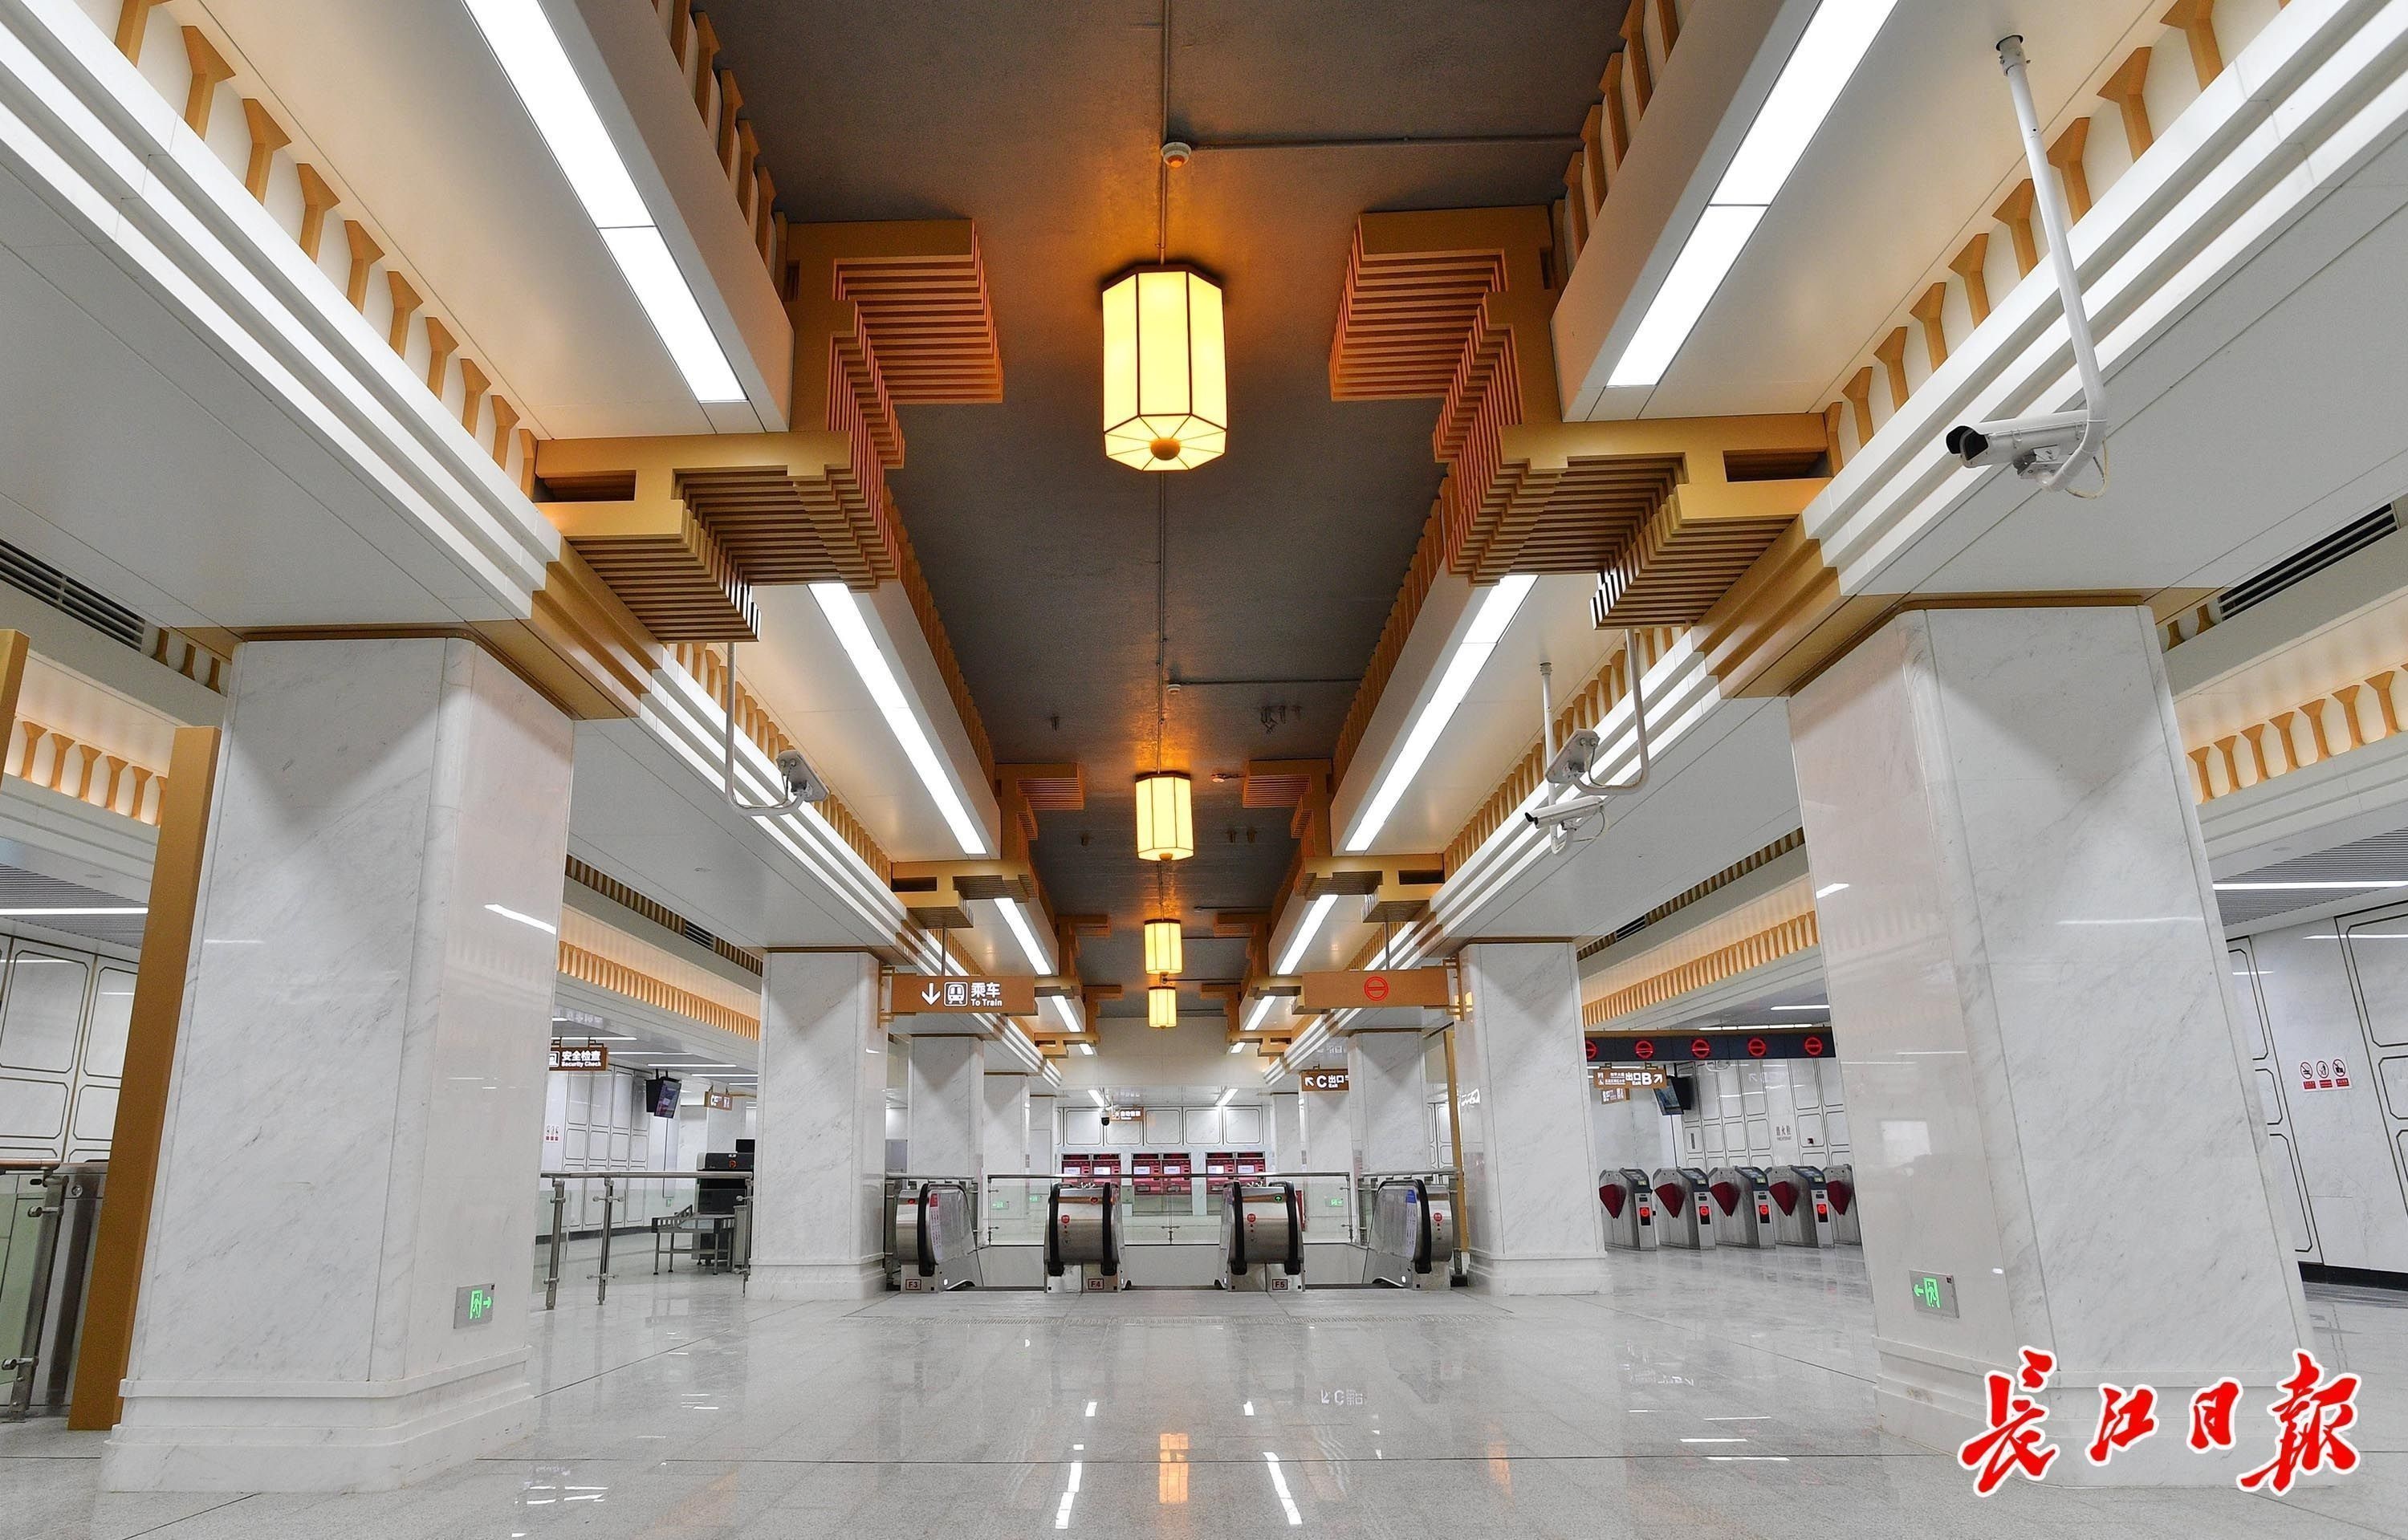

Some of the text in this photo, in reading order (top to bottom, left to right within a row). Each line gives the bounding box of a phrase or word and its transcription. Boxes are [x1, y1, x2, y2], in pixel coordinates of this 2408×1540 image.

[971, 982, 1000, 998] 乘车
[970, 998, 1003, 1006] To Train
[562, 1050, 600, 1061] 安全检查
[1328, 1075, 1344, 1083] 出口
[1625, 1071, 1641, 1081] 出口
